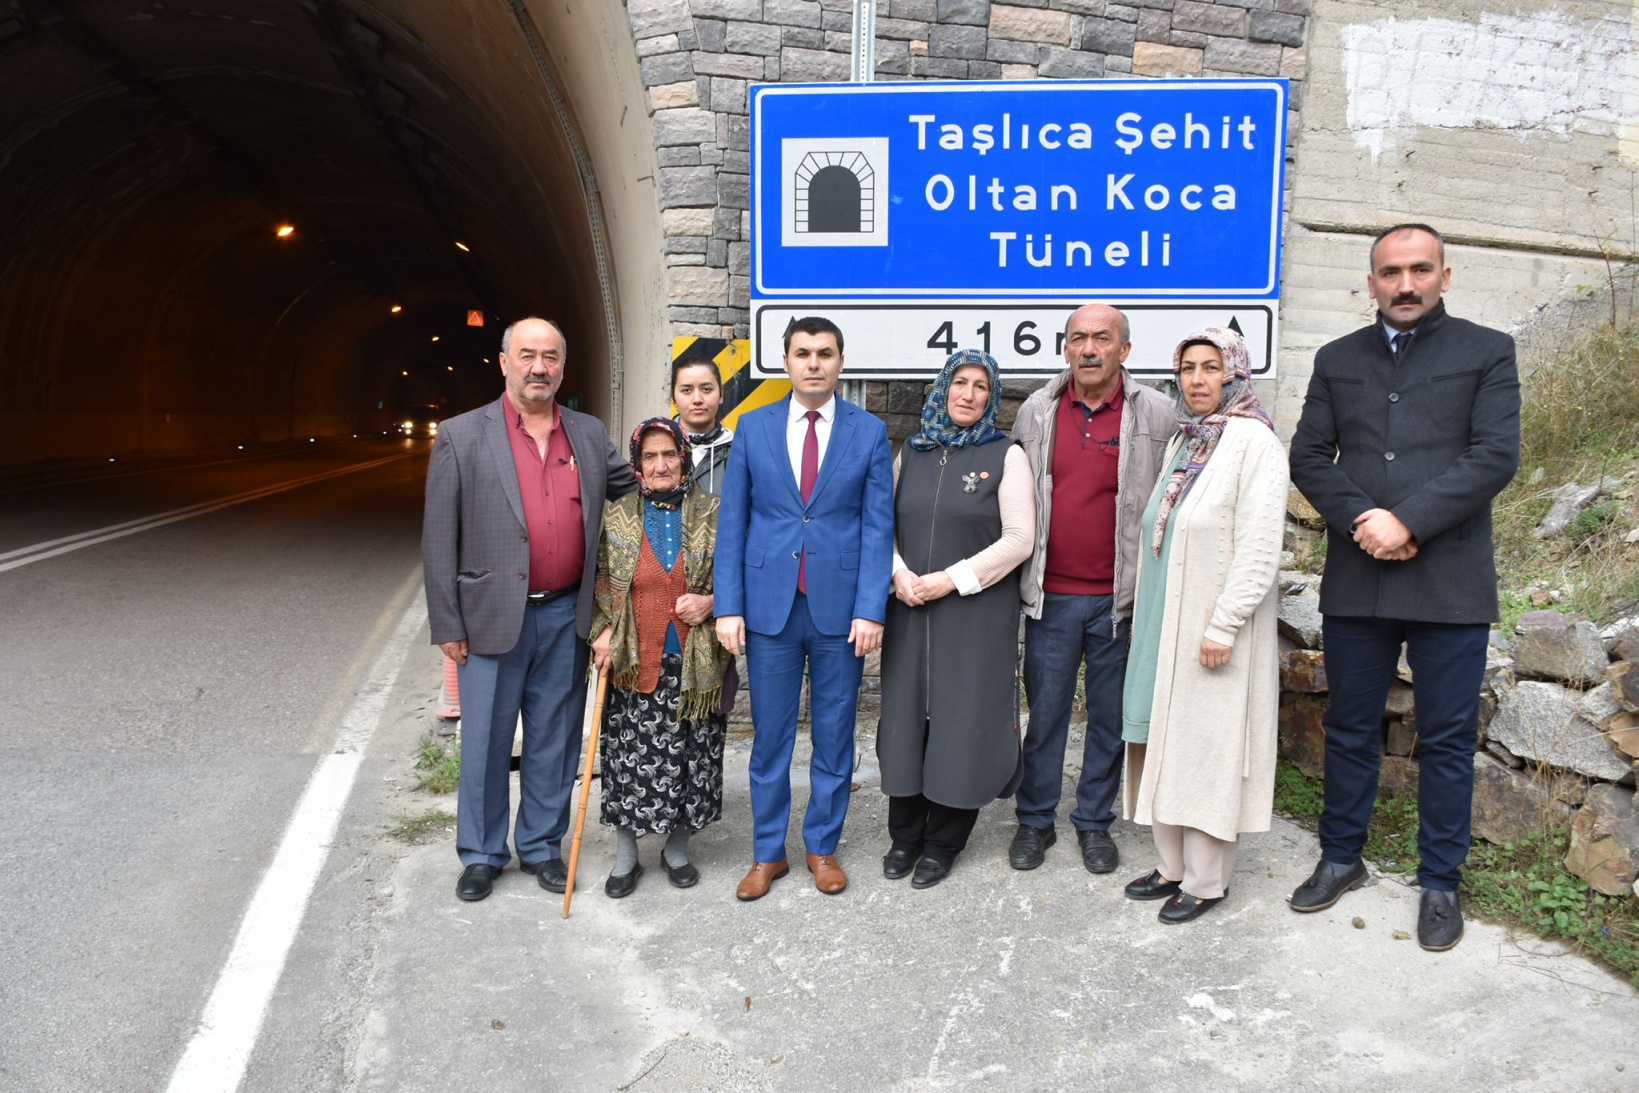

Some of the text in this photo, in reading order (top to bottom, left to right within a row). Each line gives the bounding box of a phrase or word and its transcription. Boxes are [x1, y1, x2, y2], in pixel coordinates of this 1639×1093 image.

[909, 112, 1256, 155] Taşlıca Şehit
[925, 173, 1236, 211] Oltan Koca
[990, 231, 1170, 267] Tüneli
